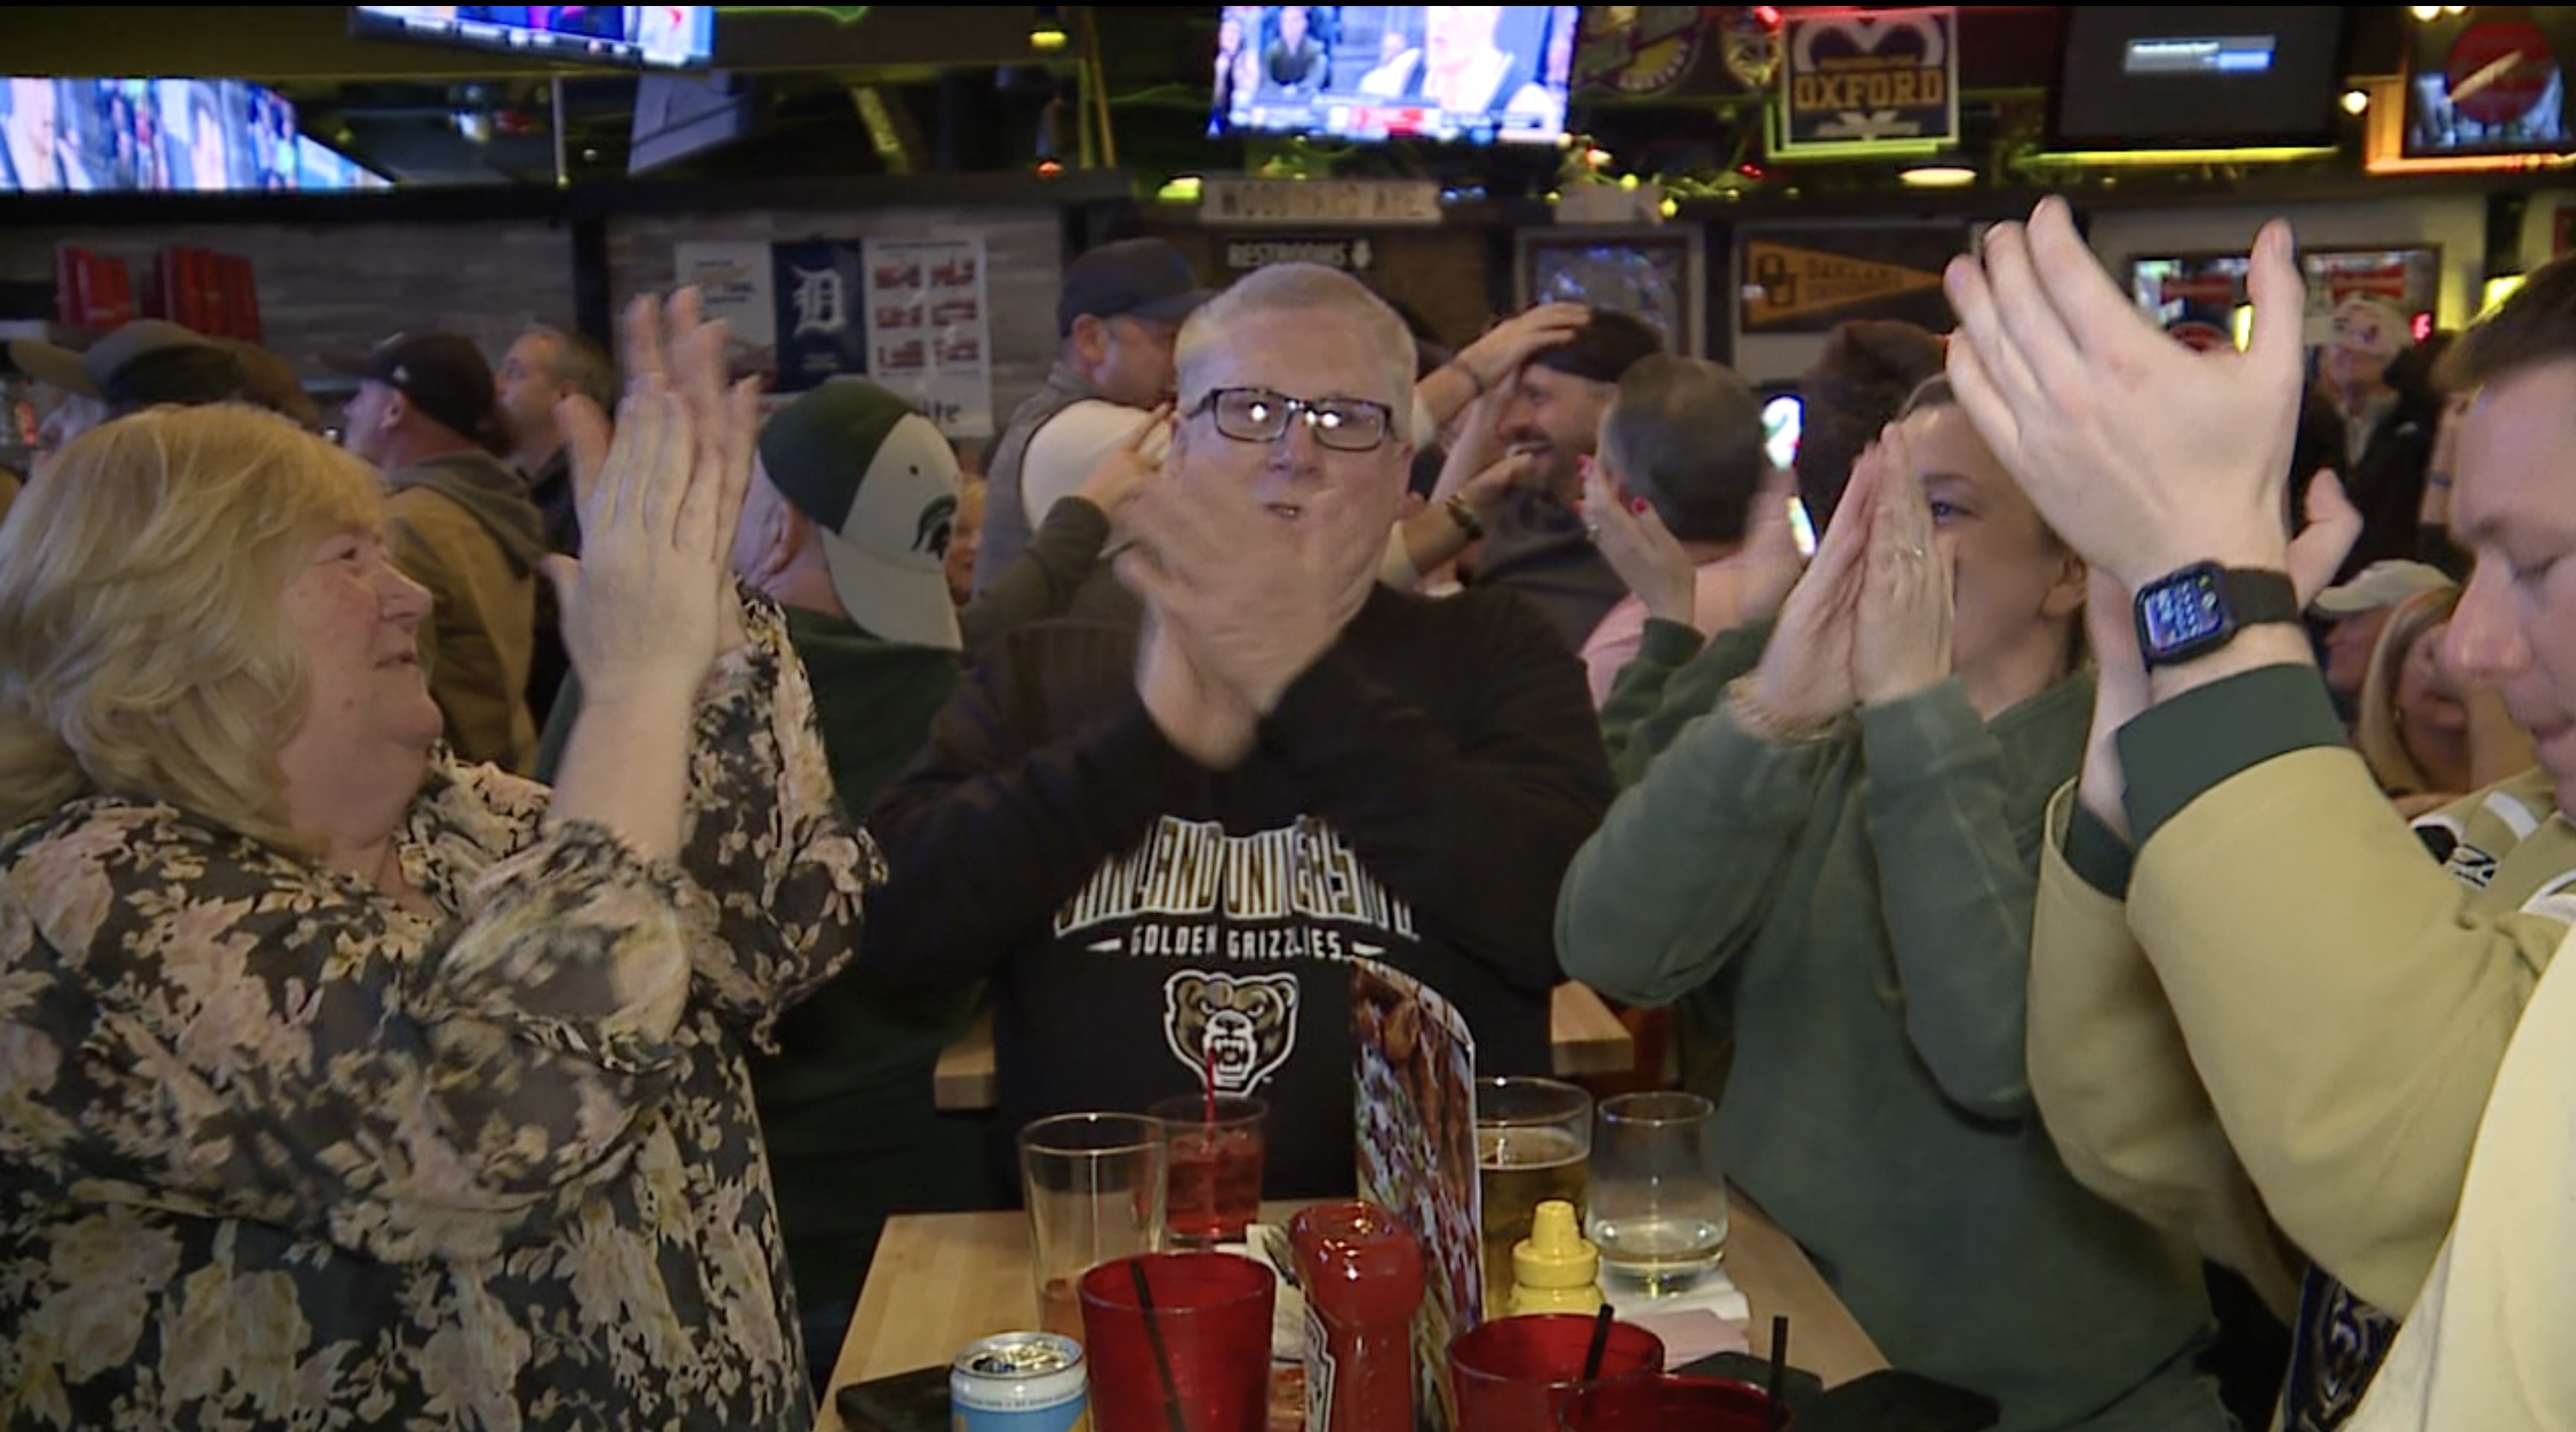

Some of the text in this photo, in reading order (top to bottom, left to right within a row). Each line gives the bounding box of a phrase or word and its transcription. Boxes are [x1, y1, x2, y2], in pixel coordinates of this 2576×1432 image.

[1793, 69, 1945, 110] OXFORD
[1228, 242, 1348, 267] RESTROOMS
[790, 264, 849, 338] D
[1130, 923, 1217, 958] GOLDEN
